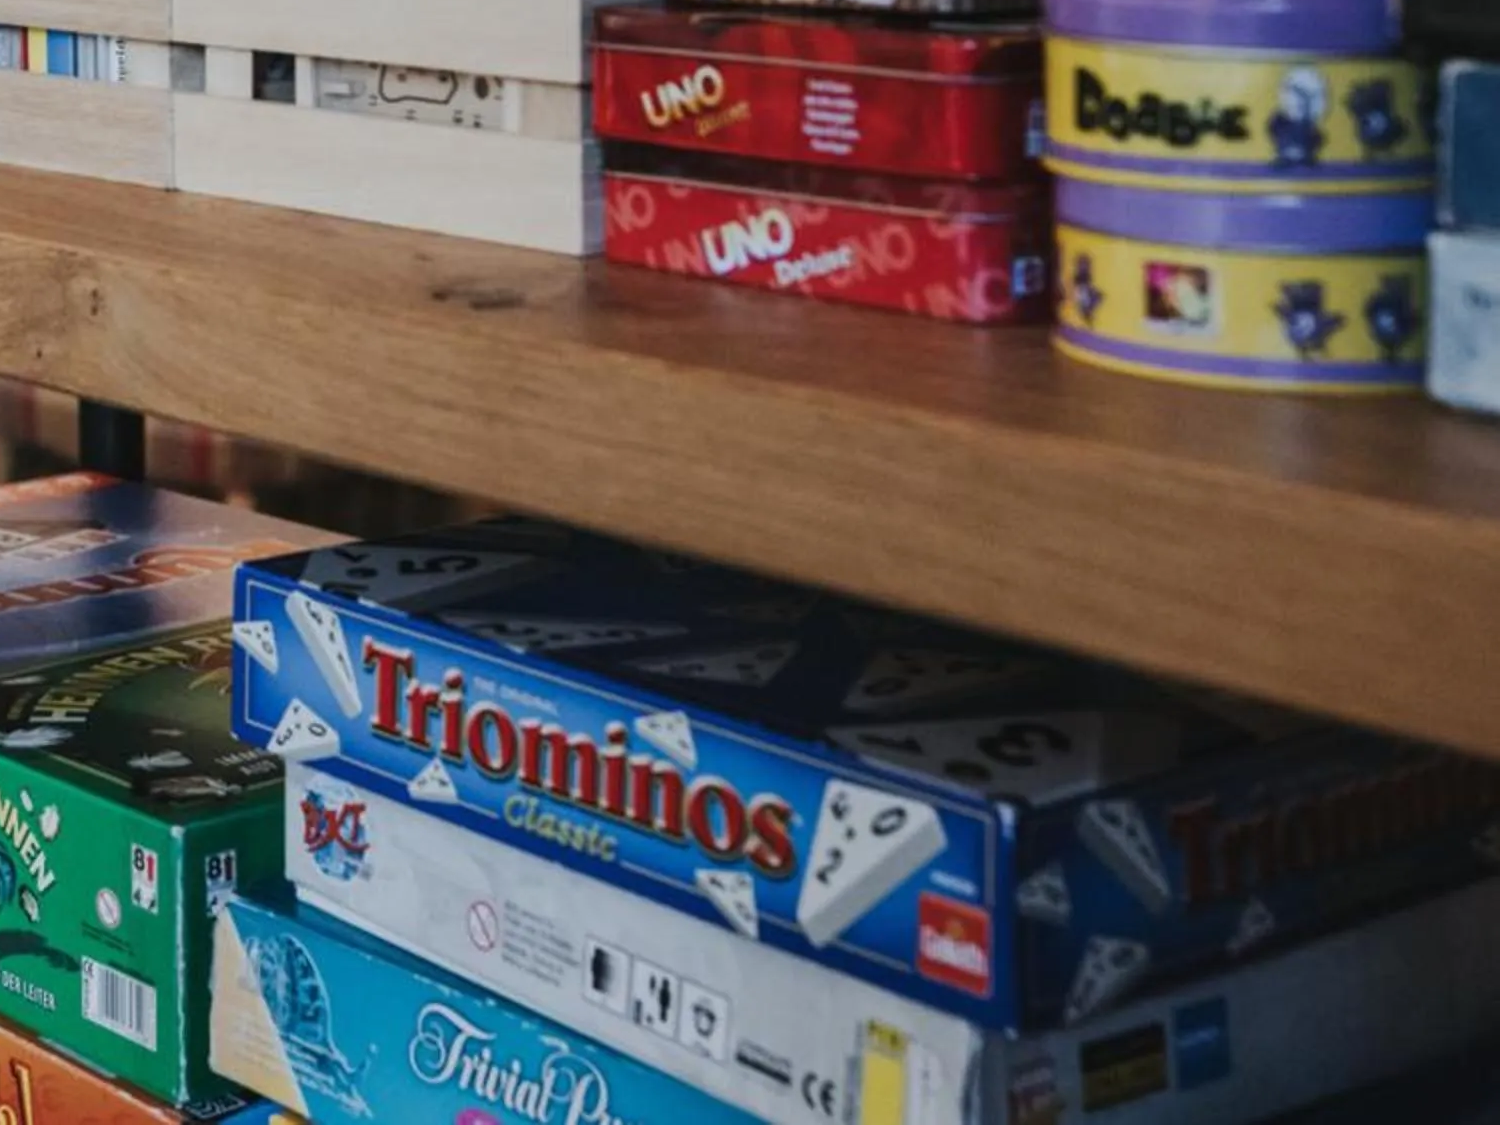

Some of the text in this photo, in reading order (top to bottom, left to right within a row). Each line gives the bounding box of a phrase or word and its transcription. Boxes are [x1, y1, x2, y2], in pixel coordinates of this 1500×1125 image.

[640, 63, 725, 128] UNO
[702, 207, 795, 277] UNO
[363, 634, 797, 880] Triominos
[503, 794, 620, 862] Classic
[1, 971, 22, 995] DER
[22, 979, 57, 1011] LEITER
[408, 1001, 556, 1125] Trivial
